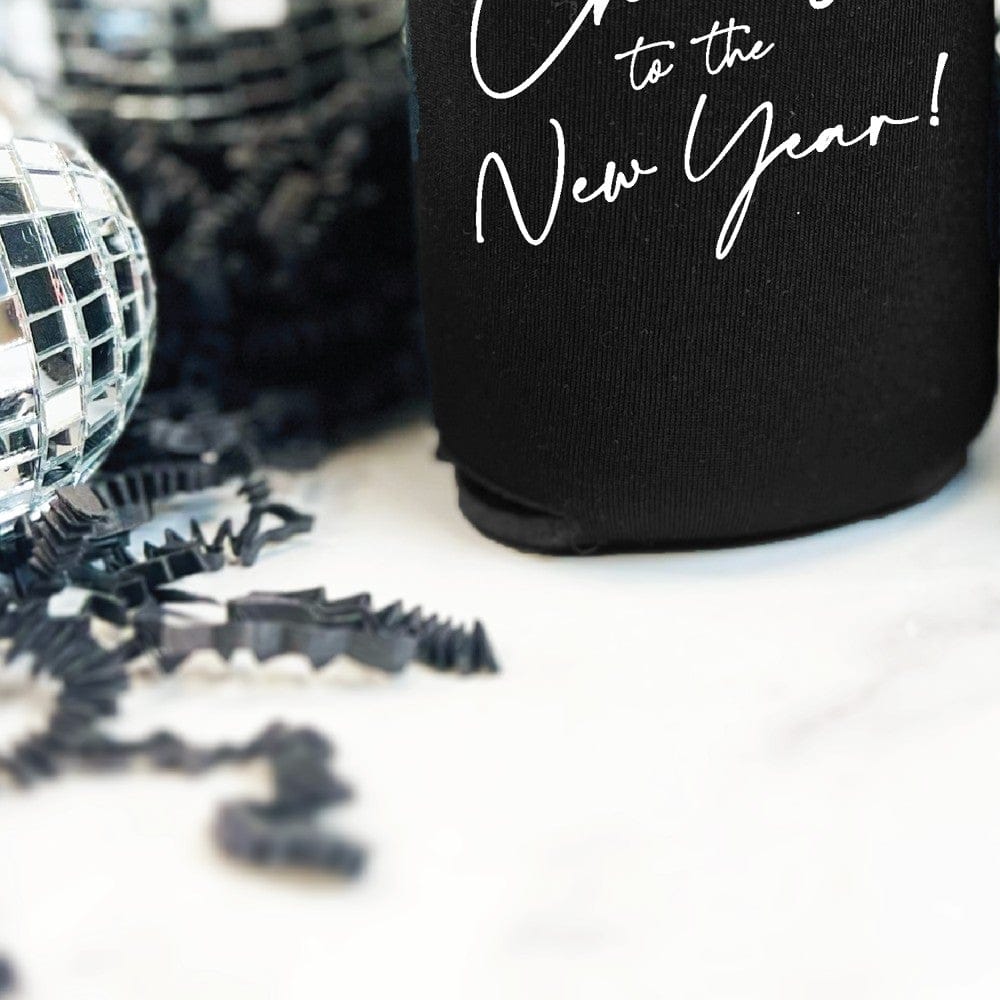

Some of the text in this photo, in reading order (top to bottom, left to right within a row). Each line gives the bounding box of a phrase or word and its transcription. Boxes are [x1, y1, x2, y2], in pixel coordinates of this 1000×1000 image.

[614, 17, 775, 91] to the
[475, 51, 949, 260] New Year!
